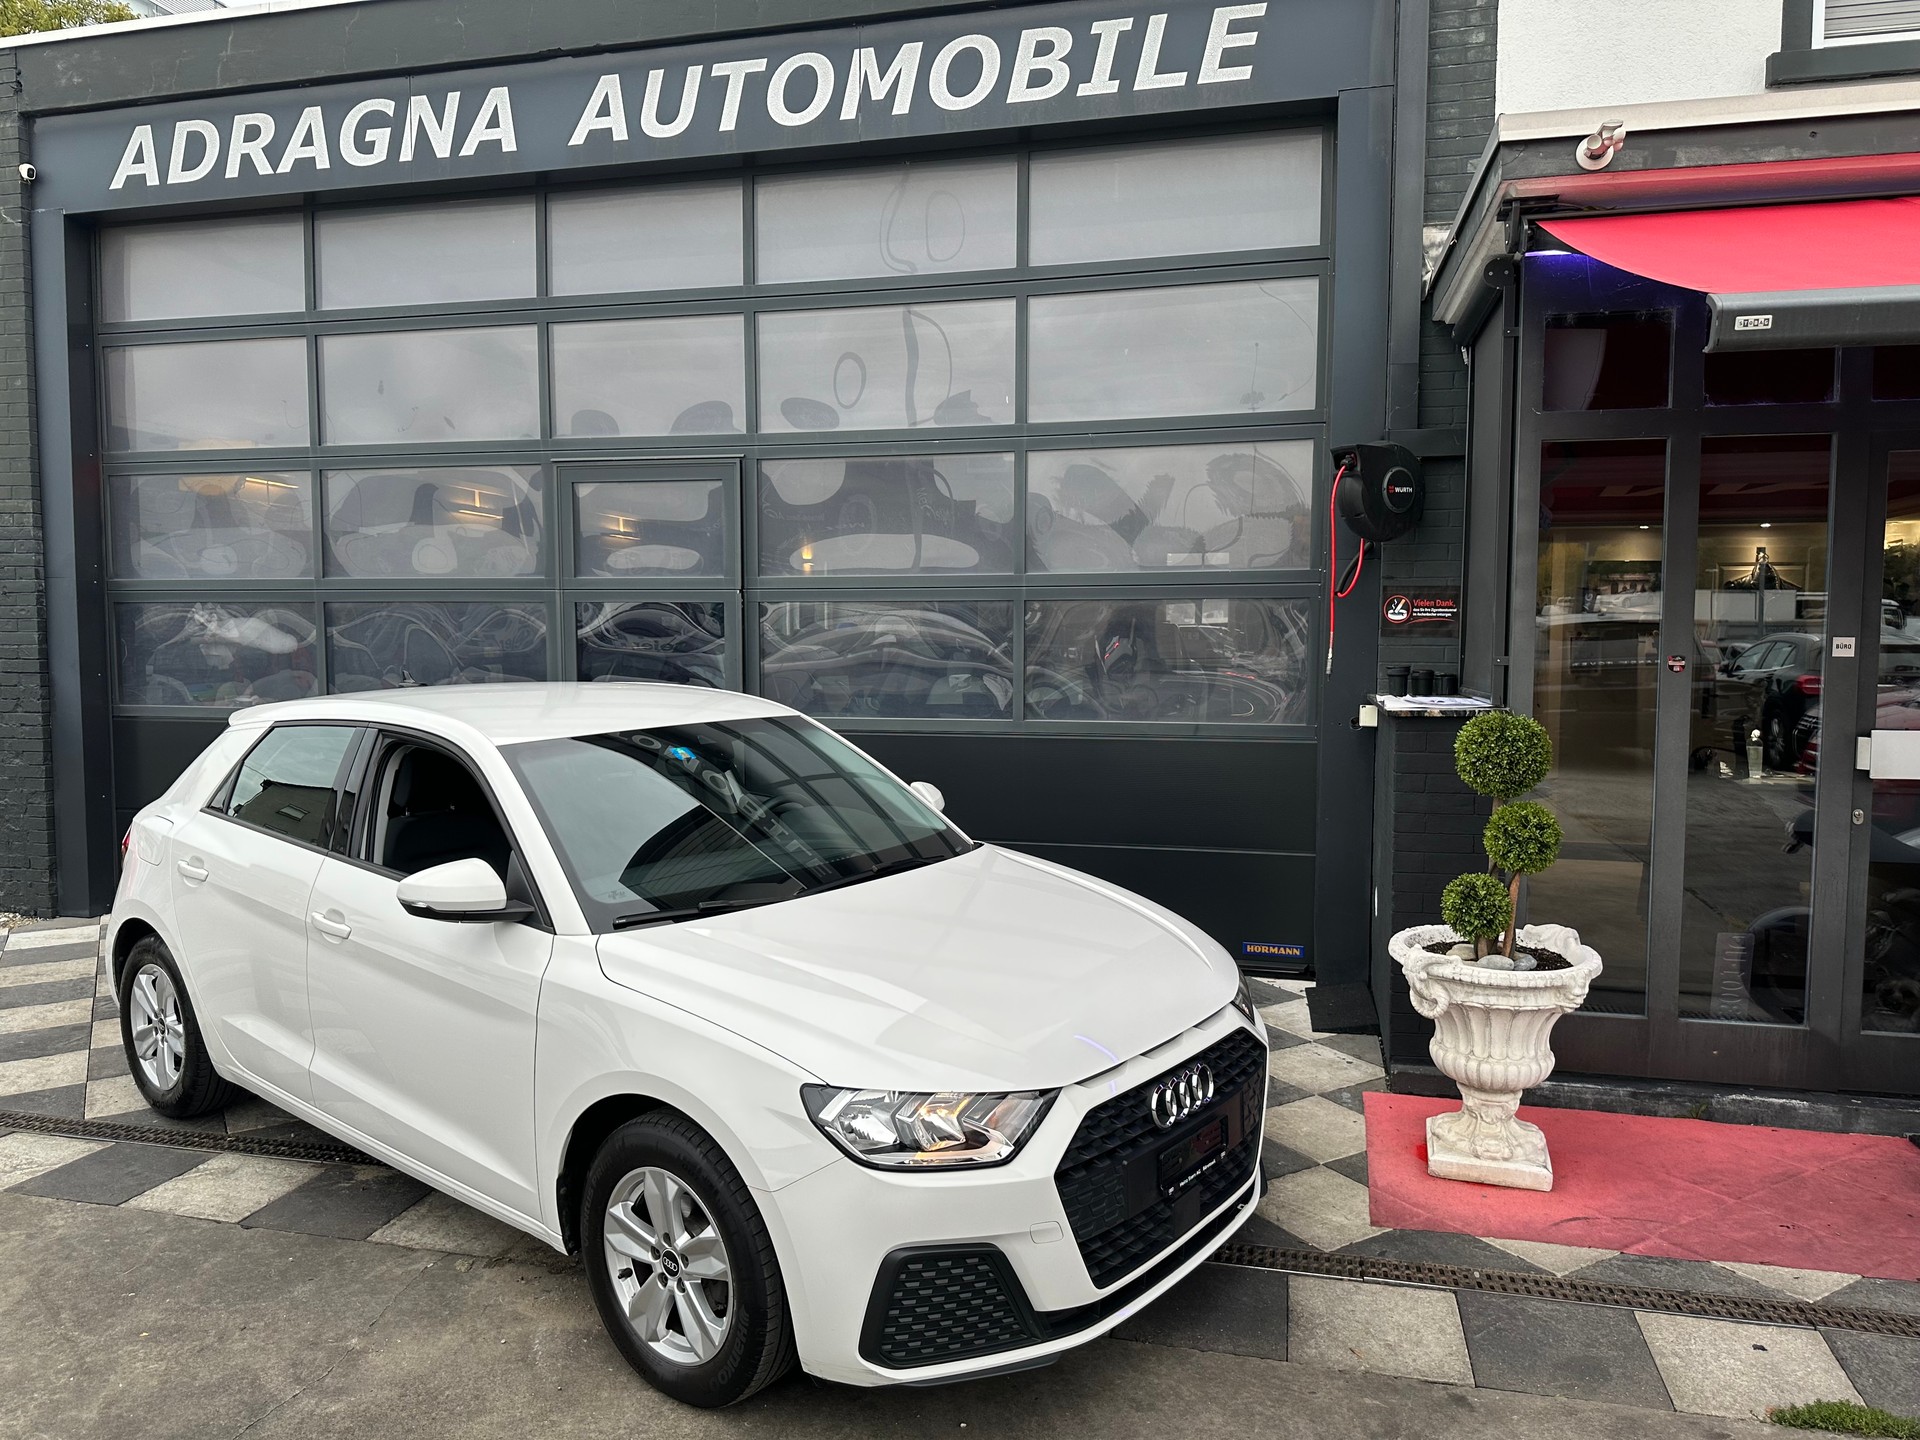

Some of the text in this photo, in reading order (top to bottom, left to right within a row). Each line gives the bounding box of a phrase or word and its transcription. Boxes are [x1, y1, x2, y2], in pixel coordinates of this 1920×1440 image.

[109, 1, 1268, 191] ADRAGNA AUTOMOBILE
[1835, 642, 1852, 650] BÜRO
